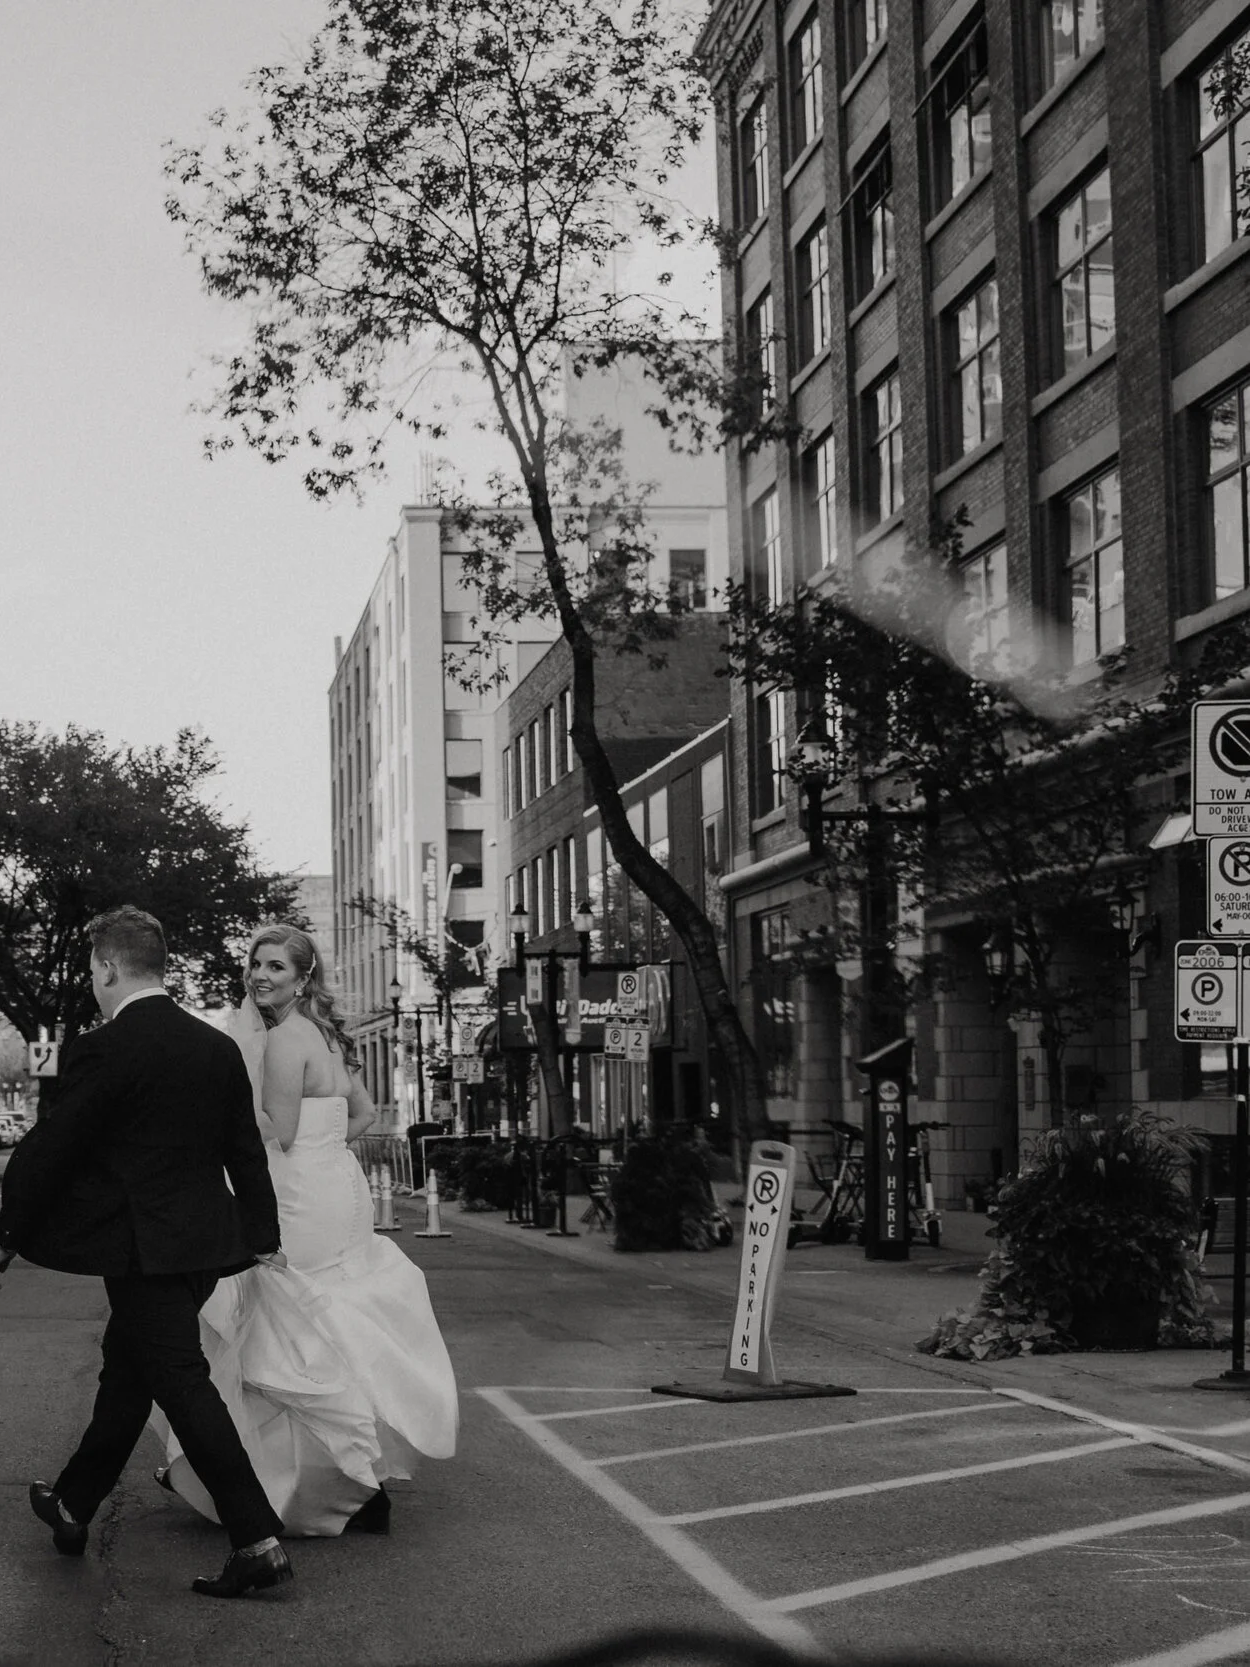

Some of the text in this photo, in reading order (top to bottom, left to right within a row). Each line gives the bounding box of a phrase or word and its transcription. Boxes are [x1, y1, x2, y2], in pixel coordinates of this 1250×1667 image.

[1210, 789, 1237, 800] TOW
[1209, 806, 1244, 815] DO NOT
[1193, 957, 1224, 967] 2006
[634, 1032, 642, 1046] 2
[886, 1114, 896, 1161] PAY
[887, 1175, 896, 1238] HERE
[740, 1221, 769, 1367] NO PARKING
